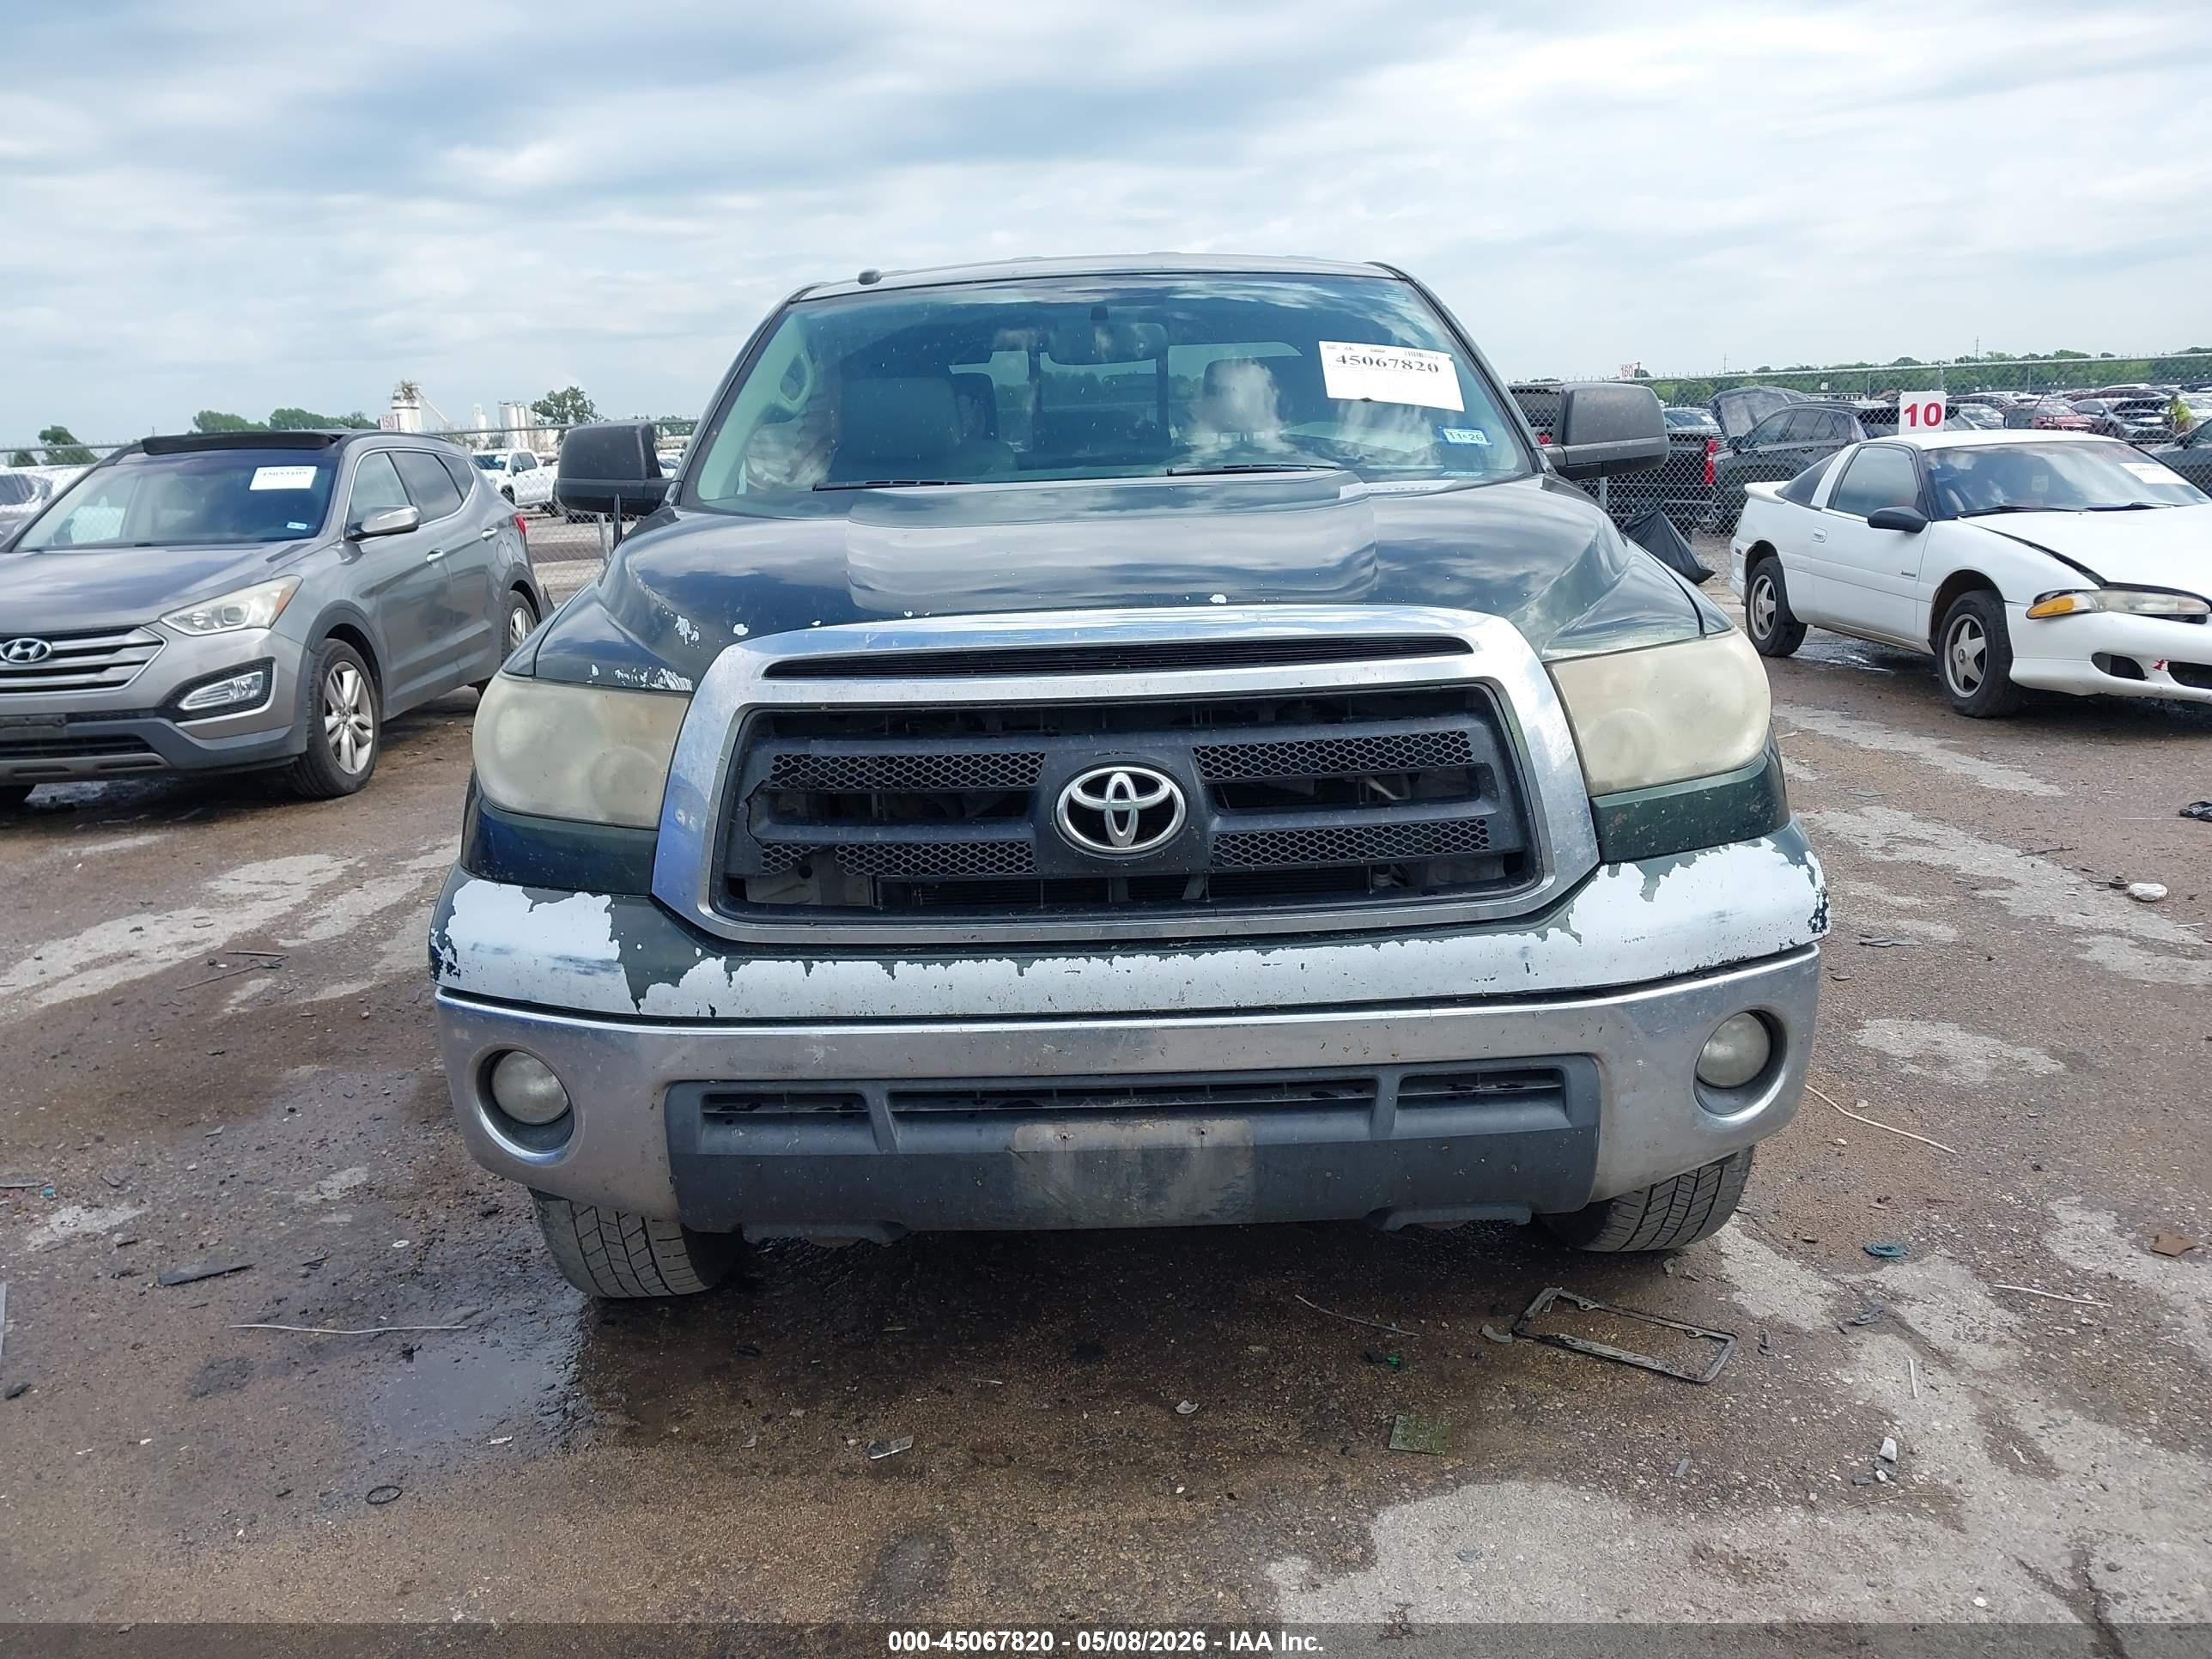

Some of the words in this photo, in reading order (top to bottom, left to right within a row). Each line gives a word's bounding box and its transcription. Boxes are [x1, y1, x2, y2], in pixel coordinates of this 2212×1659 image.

[1335, 354, 1439, 374] 45067820
[1620, 364, 1633, 378] 160
[1904, 402, 1942, 427] 10
